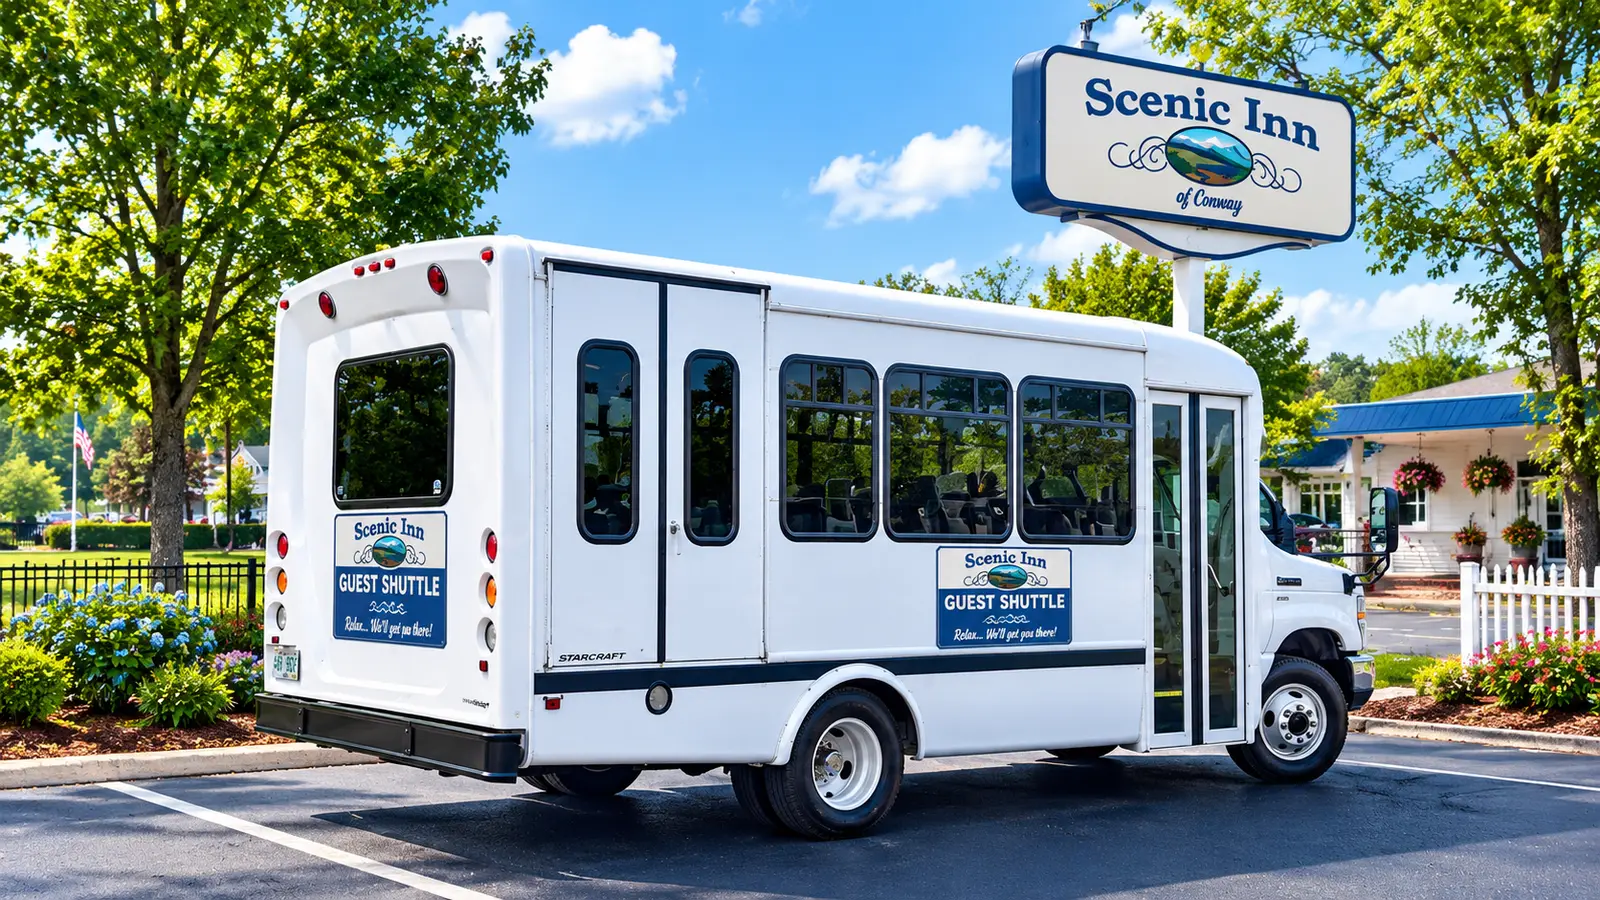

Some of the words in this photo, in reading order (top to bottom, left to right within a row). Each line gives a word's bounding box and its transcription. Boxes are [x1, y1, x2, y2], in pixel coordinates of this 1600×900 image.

[1085, 78, 1231, 126] Scenic
[1244, 97, 1320, 151] Inn
[1176, 187, 1193, 209] of
[1194, 188, 1243, 217] Conway
[354, 516, 397, 541] Scenic
[400, 518, 424, 541] Inn
[965, 550, 1016, 568] Scenic
[1020, 551, 1047, 569] Inn
[339, 573, 378, 593] GUEST
[381, 574, 440, 597] SHUTTLE
[944, 594, 995, 610] GUEST
[1000, 594, 1065, 609] SHUTTLE
[412, 621, 433, 638] there!
[1035, 626, 1058, 638] there!
[558, 652, 626, 662] STARCRAFT
